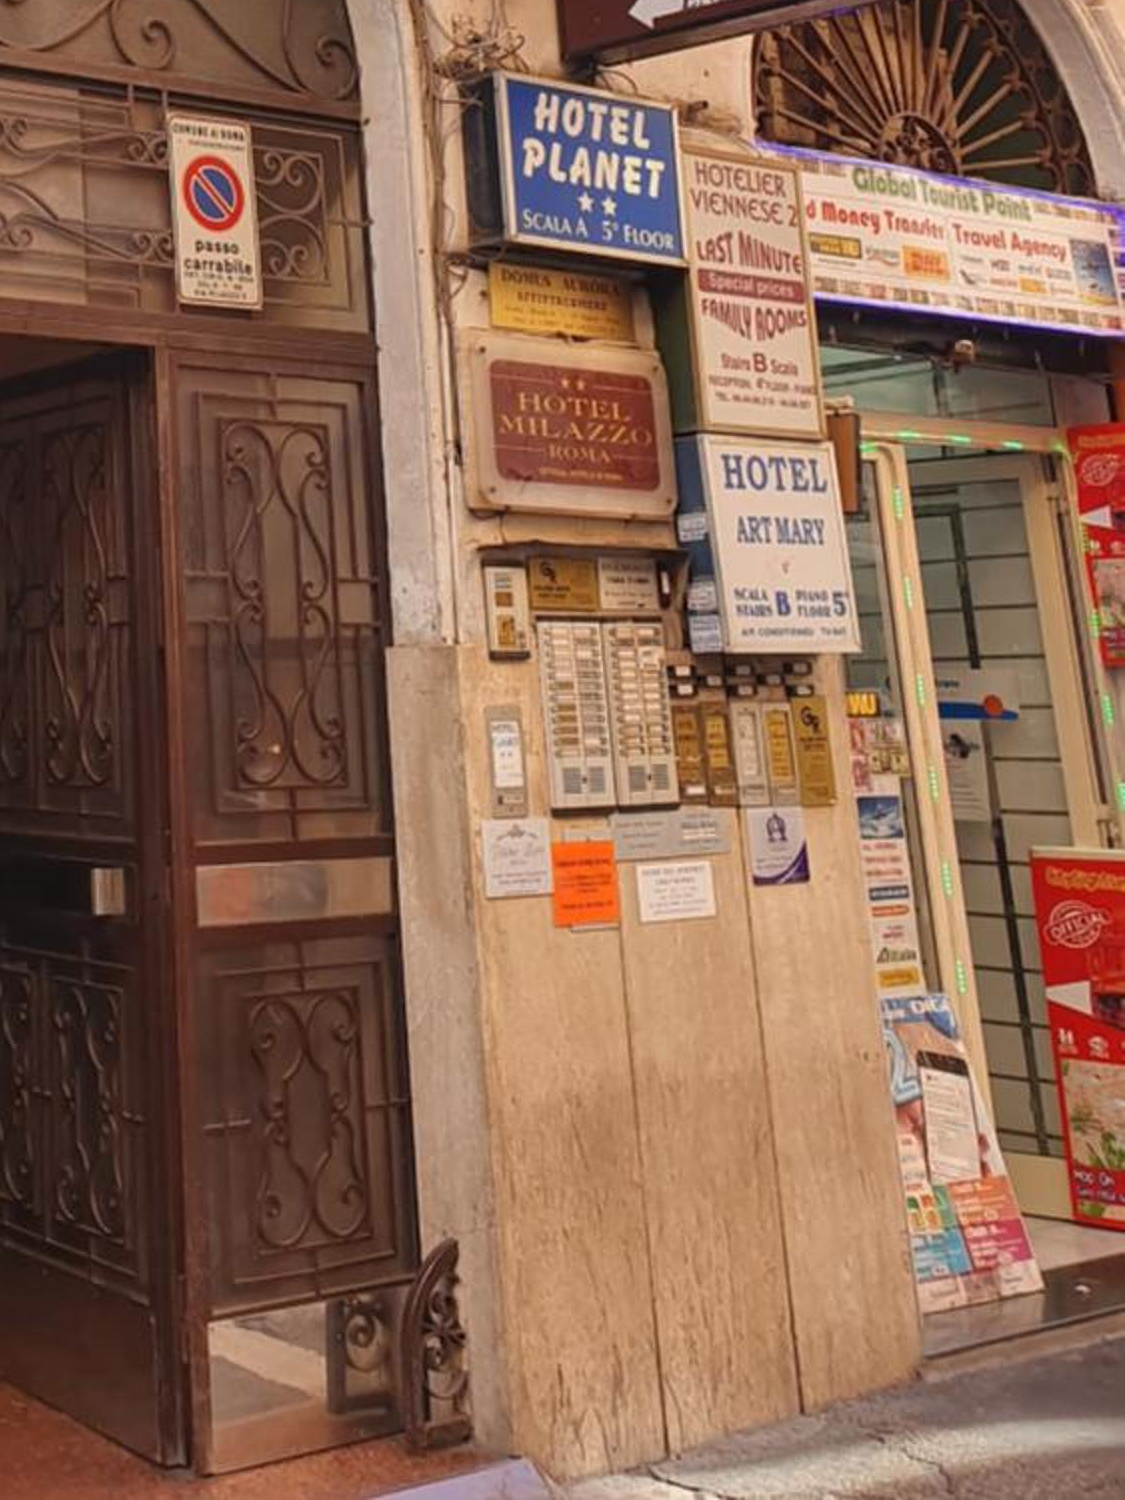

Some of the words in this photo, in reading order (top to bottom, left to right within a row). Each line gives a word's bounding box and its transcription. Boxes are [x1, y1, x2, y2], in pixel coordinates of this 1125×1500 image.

[533, 92, 651, 149] HOTEL
[522, 137, 666, 199] PLANET
[695, 161, 786, 198] HOTELIER
[689, 188, 784, 224] VIENNESE
[852, 167, 917, 199] Global
[919, 179, 980, 213] Tourist
[981, 191, 1032, 221] Point
[522, 209, 574, 234] SCALA
[575, 216, 588, 238] A
[624, 226, 675, 250] FLOOR
[821, 201, 880, 234] Money
[952, 222, 1007, 250] Travel
[1010, 232, 1067, 262] Agency
[194, 240, 239, 256] passo
[696, 231, 734, 265] LAST
[738, 229, 802, 274] MINUTE
[184, 257, 253, 276] carrabile
[757, 281, 794, 298] prices
[700, 298, 752, 340] FAMILY
[755, 307, 807, 341] ROOMS
[752, 353, 768, 373] B
[770, 359, 798, 376] Scala
[518, 391, 631, 421] HOTEL
[498, 414, 653, 446] MILAZZO
[548, 444, 611, 463] ROMA
[721, 454, 828, 493] HOTEL
[737, 516, 772, 544] ART
[774, 517, 825, 545] MARY
[734, 588, 768, 602] SCALA
[775, 591, 791, 616] B
